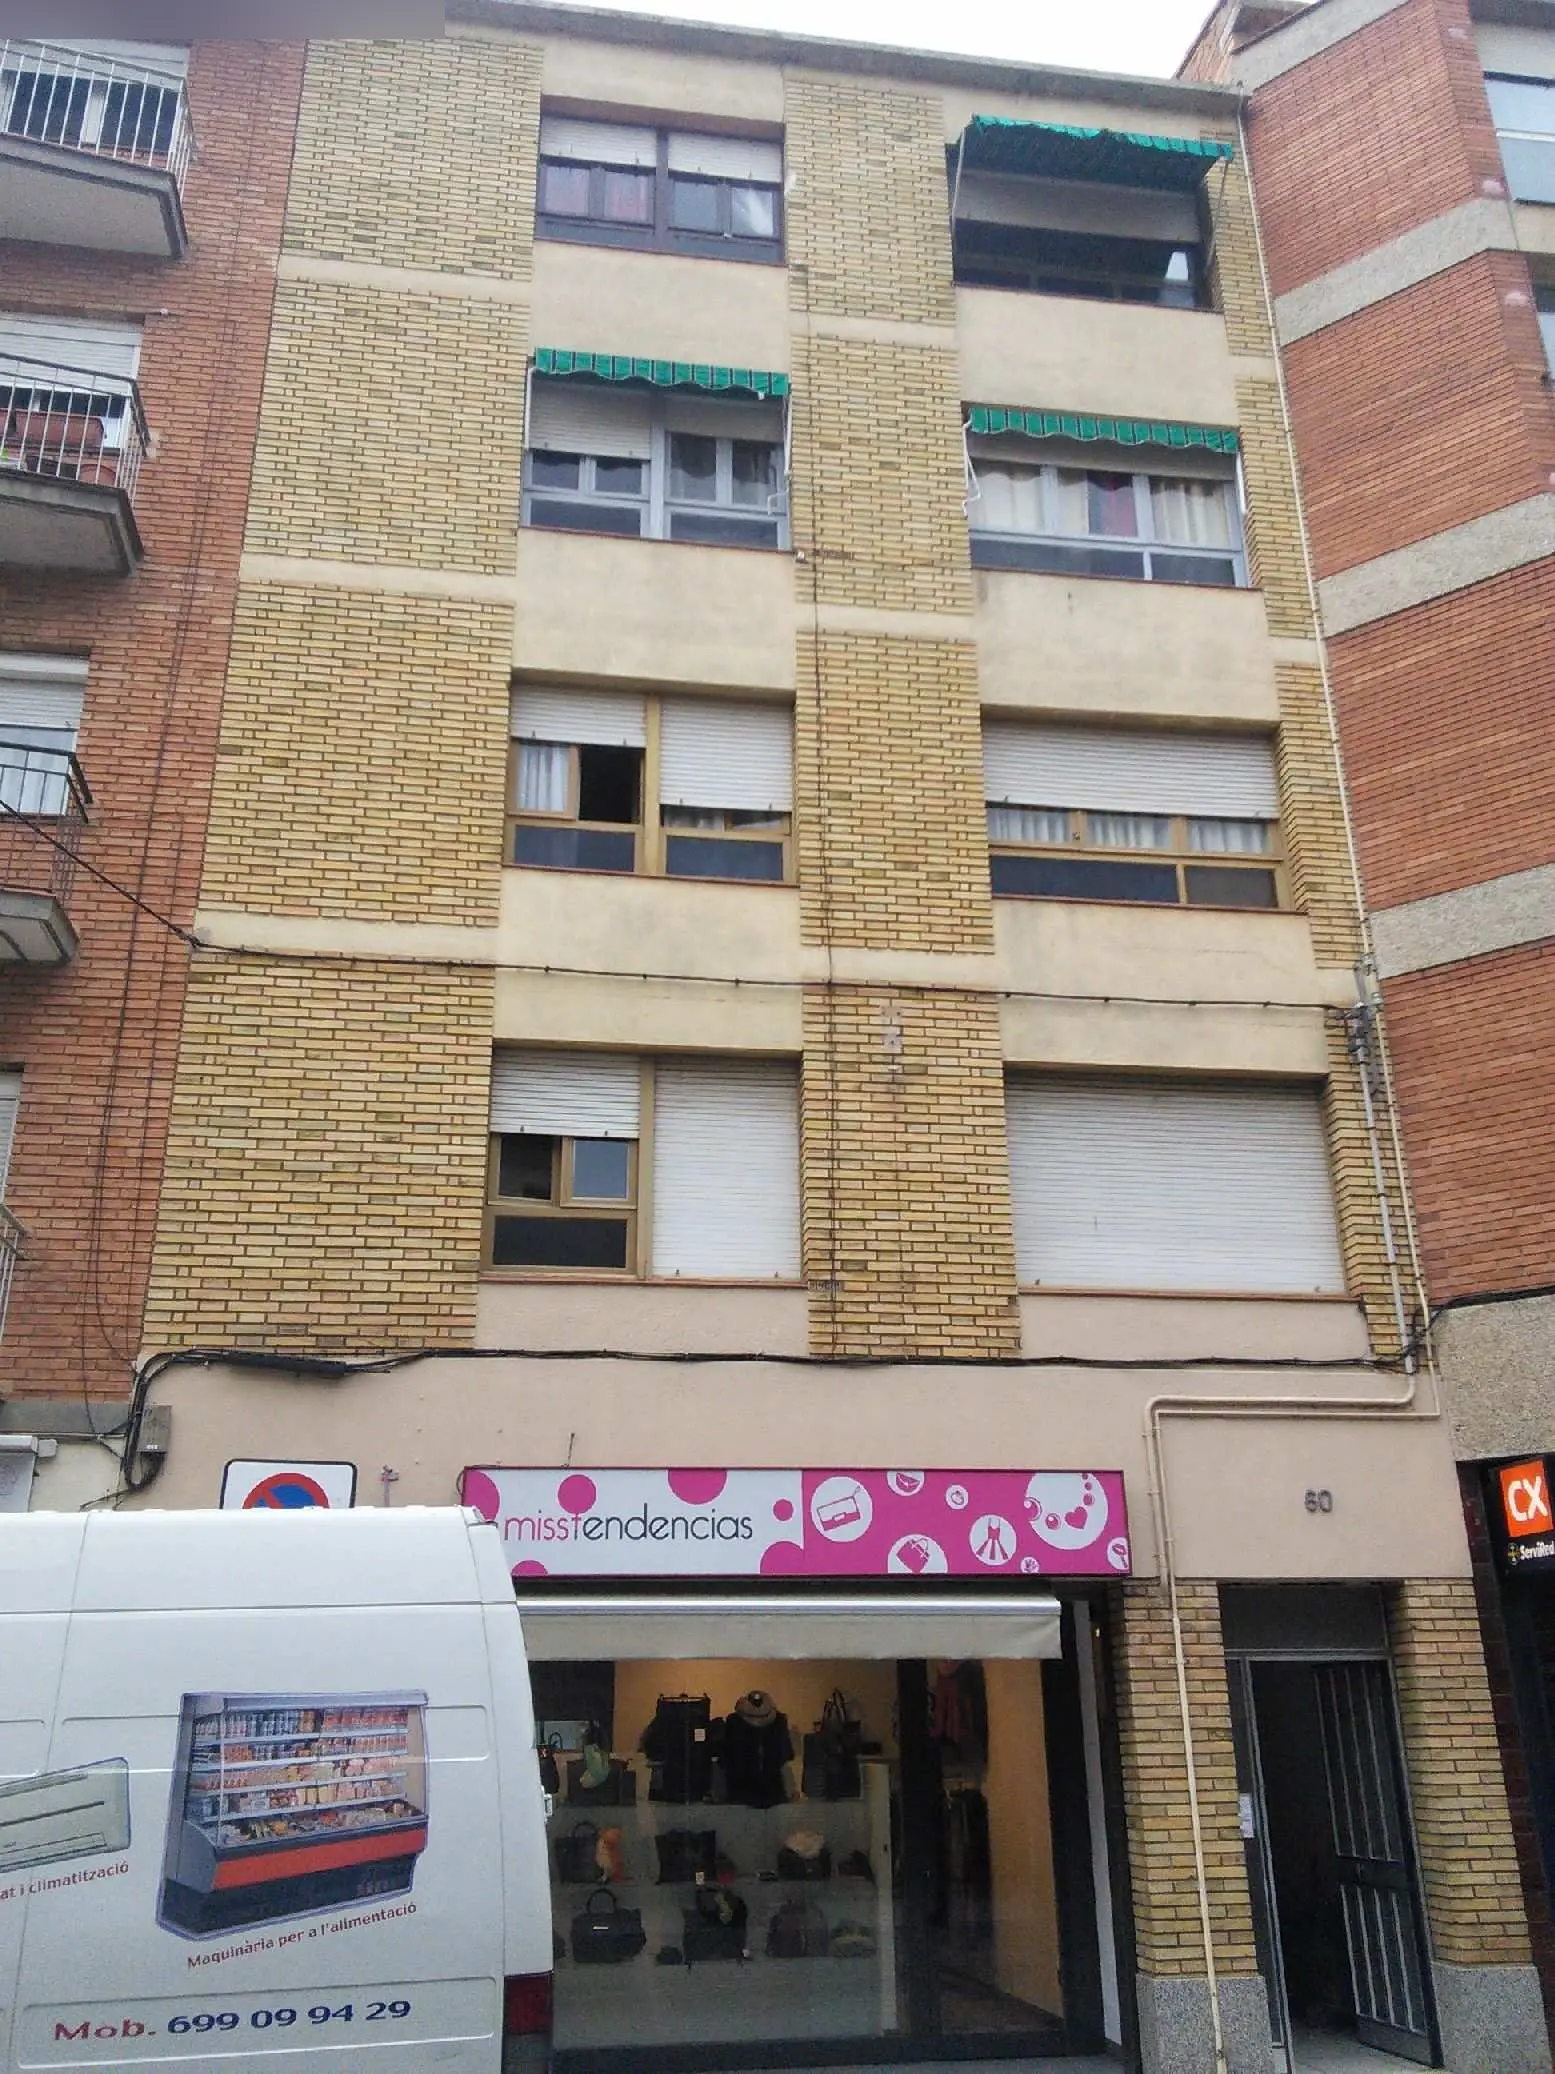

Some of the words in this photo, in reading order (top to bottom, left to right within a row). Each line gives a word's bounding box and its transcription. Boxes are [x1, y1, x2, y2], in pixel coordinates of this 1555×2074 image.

[1304, 1489, 1333, 1513] 60
[1507, 1475, 1549, 1522] CX
[503, 1502, 753, 1542] misstendencias
[28, 1860, 130, 1894] climatització
[186, 1939, 275, 1970] Maquinària
[277, 1930, 306, 1949] per
[308, 1928, 318, 1939] a
[320, 1901, 418, 1936] l'alimentació
[54, 2018, 157, 2041] Mob.
[166, 2011, 241, 2035] 699
[250, 2007, 298, 2030] 09
[306, 2003, 355, 2025] 94
[364, 1999, 412, 2021] 29
